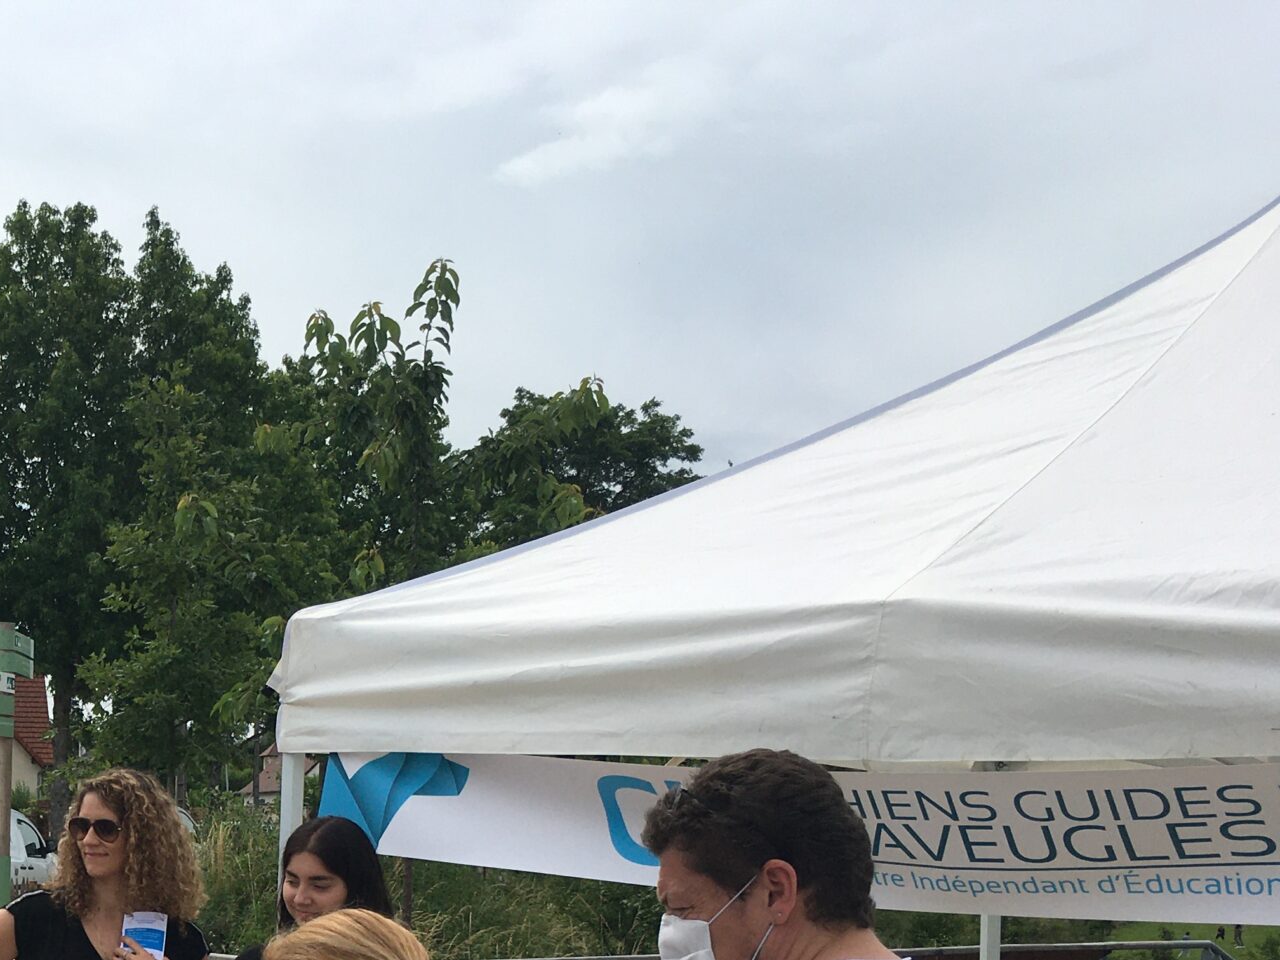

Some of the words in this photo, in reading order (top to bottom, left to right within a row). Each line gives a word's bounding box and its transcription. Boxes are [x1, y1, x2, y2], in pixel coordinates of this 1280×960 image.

[597, 774, 681, 866] C
[848, 789, 998, 822] HIENS
[1013, 784, 1263, 822] GUIDES
[871, 819, 1278, 864] AVEUGLES
[873, 871, 905, 887] tre
[911, 870, 1090, 898] Indépendant
